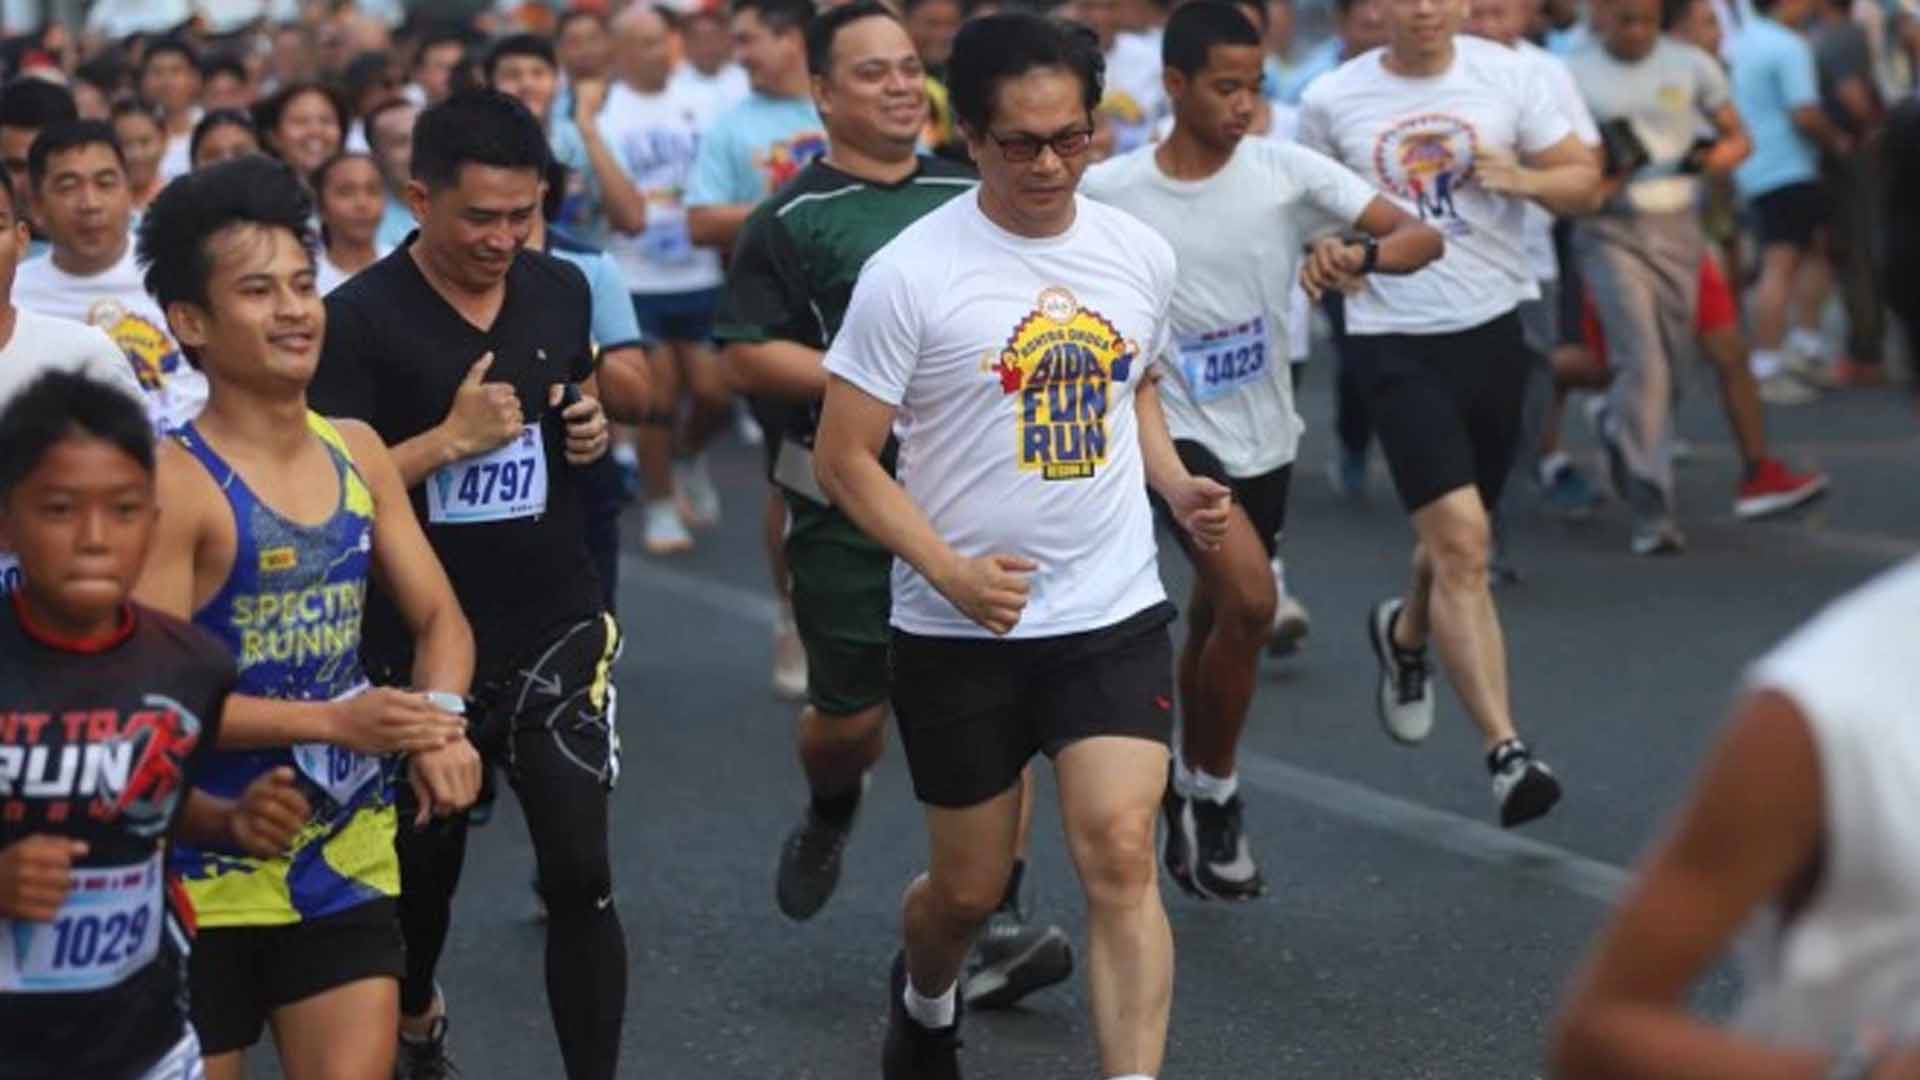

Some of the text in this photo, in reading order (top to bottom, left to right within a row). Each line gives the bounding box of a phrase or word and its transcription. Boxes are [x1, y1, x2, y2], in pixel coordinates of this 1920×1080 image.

[1028, 343, 1108, 386] BIDA
[1204, 341, 1265, 387] 4423
[1023, 382, 1107, 422] FUN
[1023, 421, 1107, 463] RUN
[457, 456, 536, 507] 4797
[52, 902, 150, 969] 1029
